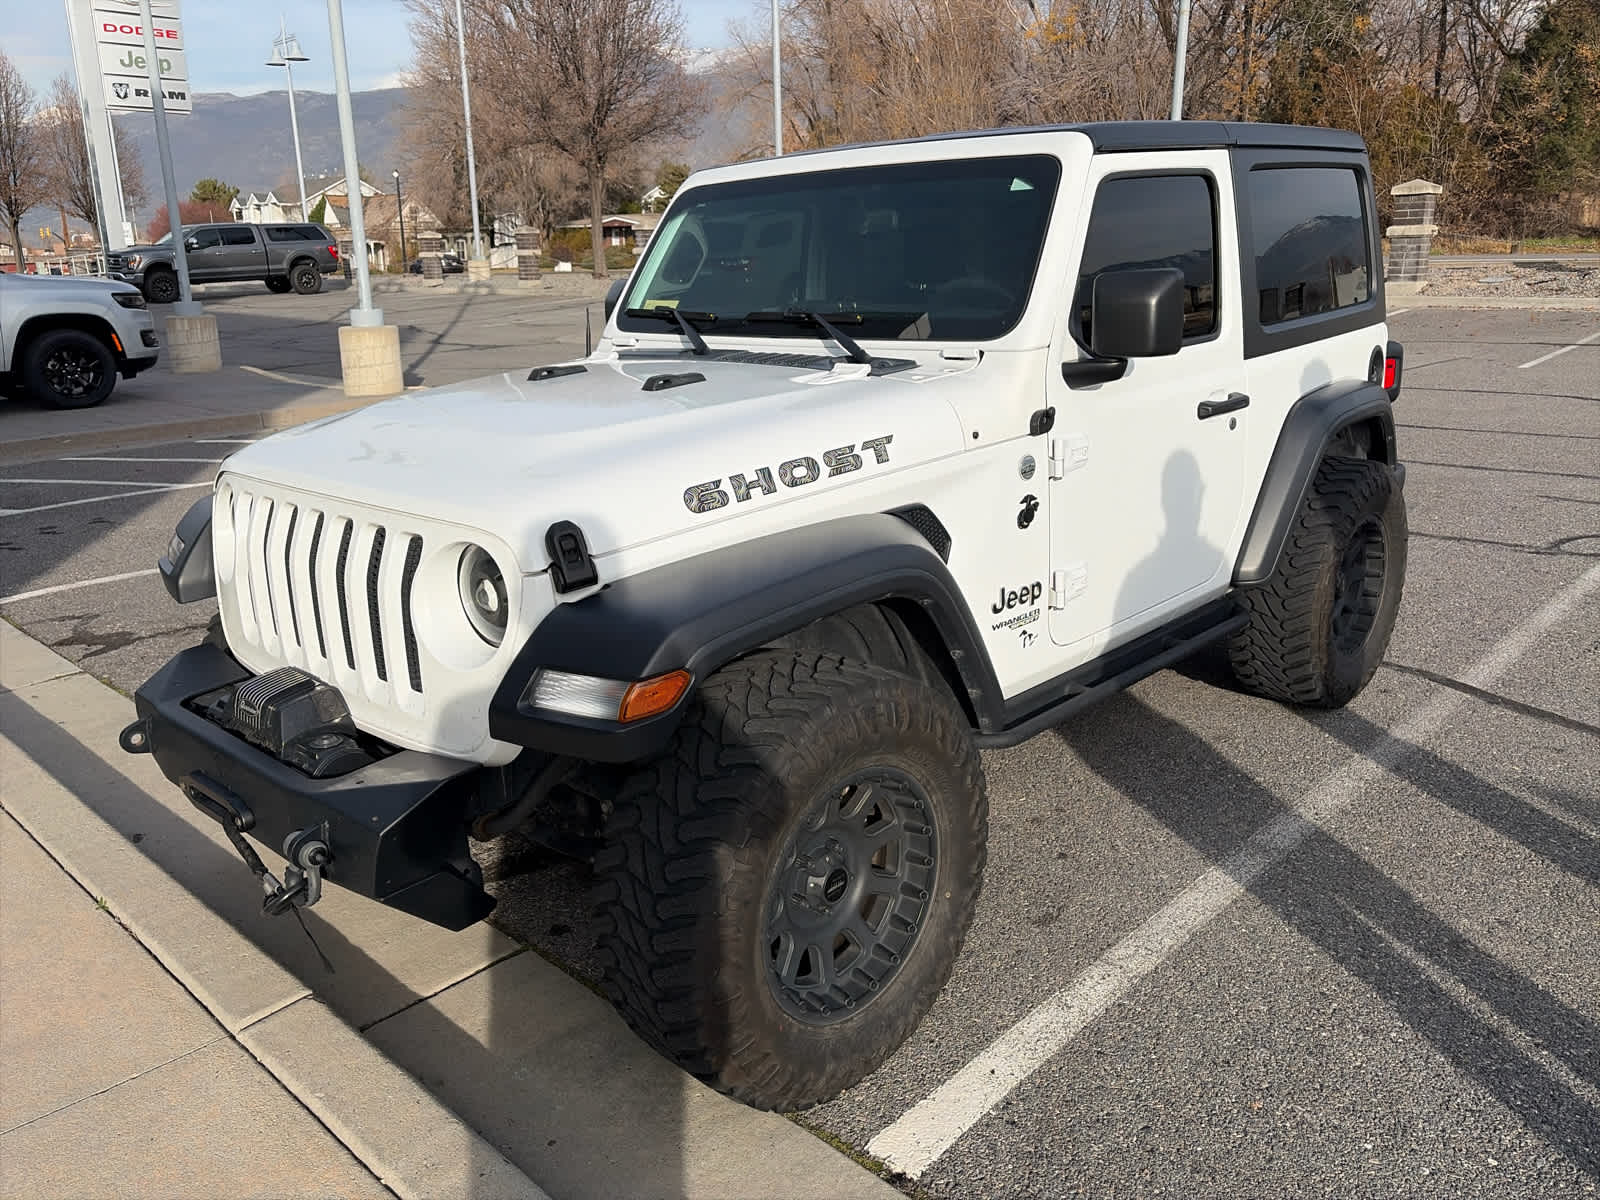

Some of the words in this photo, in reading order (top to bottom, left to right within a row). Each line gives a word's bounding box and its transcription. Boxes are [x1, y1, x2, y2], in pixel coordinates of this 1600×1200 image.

[119, 50, 172, 74] Jep
[683, 434, 893, 514] GHOST
[992, 581, 1042, 614] Jeep
